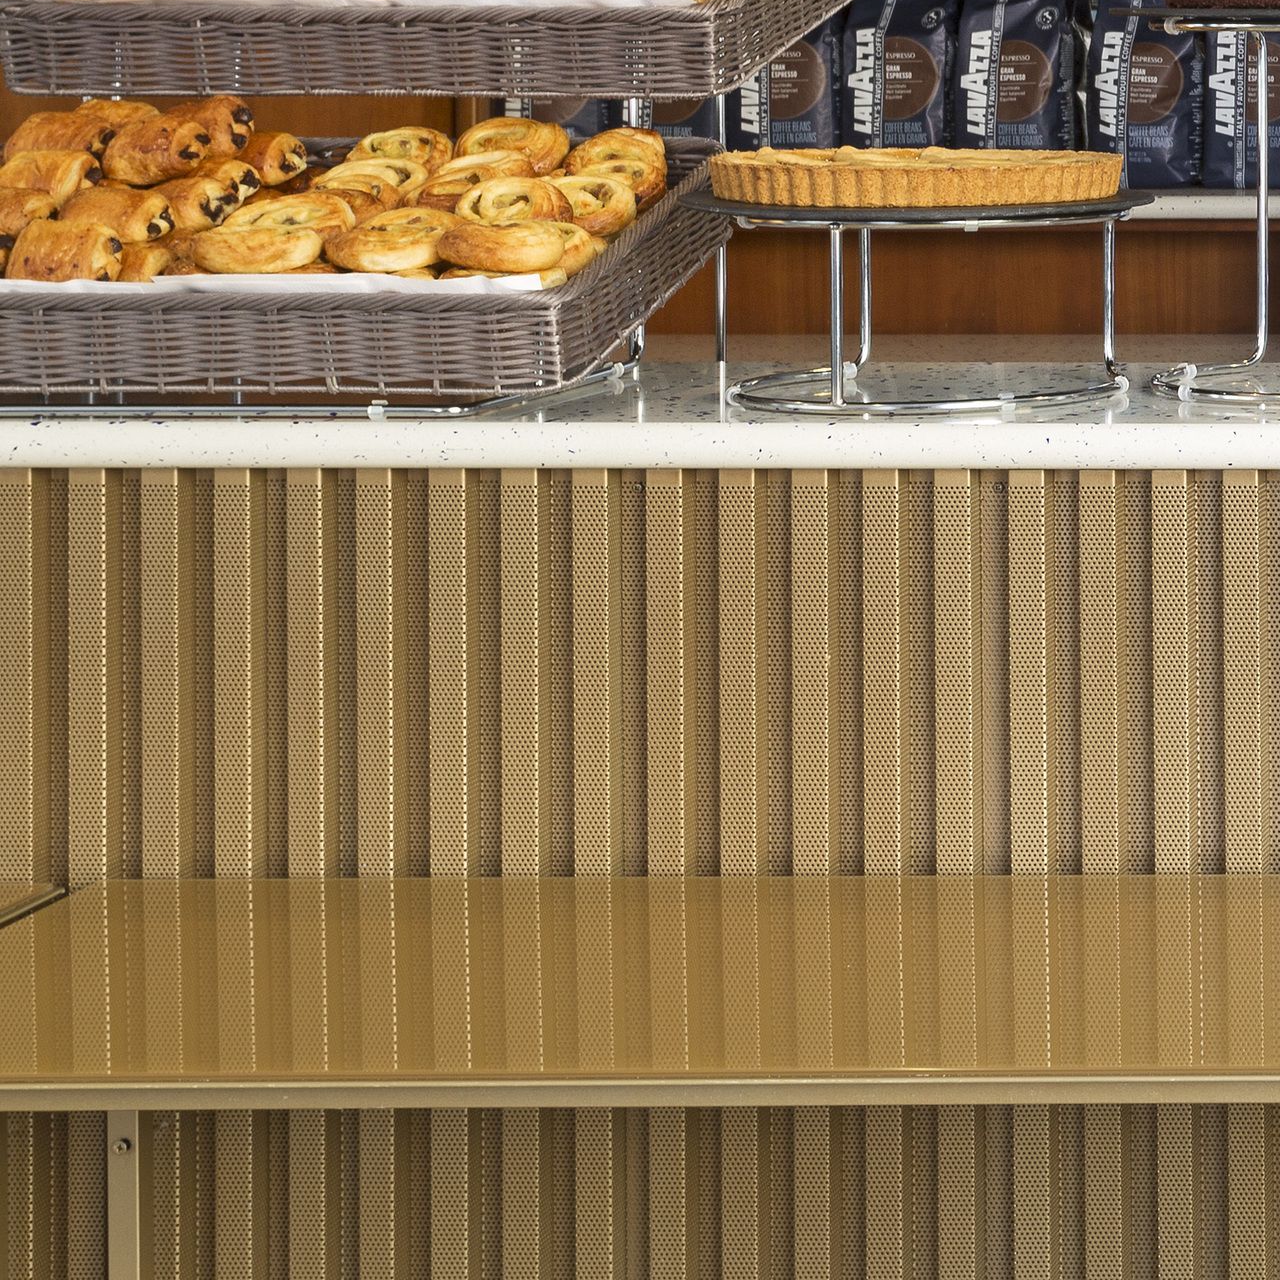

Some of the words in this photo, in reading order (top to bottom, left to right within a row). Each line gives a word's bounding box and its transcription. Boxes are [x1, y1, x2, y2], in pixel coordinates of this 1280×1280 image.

[876, 30, 884, 57] COFFEE
[991, 31, 1001, 60] COFFEE
[1122, 34, 1132, 60] COFFEE
[741, 71, 759, 134] LAVA
[848, 28, 876, 134] LAVAZZA
[961, 30, 992, 136] LAVAZZA
[988, 62, 997, 106] FAVOURITE
[1095, 32, 1124, 137] LAVAZZA
[1119, 62, 1128, 107] FAVOURITE
[1209, 31, 1236, 136] LAVAZZA
[987, 107, 995, 136] ITALY'S
